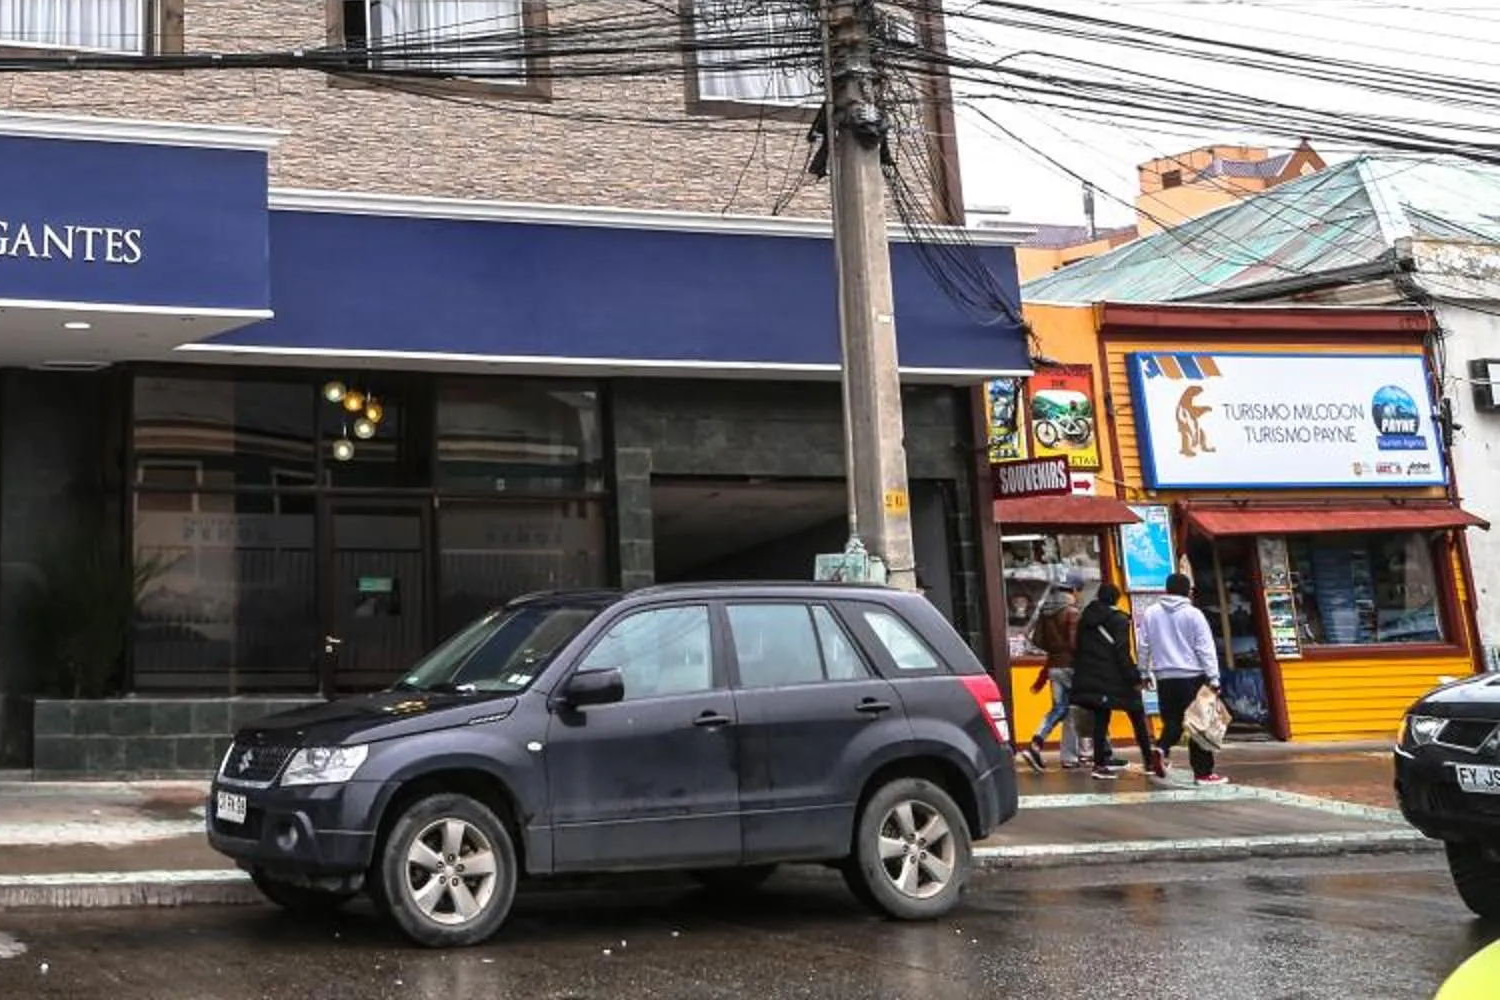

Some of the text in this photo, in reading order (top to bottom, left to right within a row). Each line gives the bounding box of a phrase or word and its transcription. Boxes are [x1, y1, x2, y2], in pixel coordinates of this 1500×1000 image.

[1222, 403, 1365, 421] TURISMO MILODON
[1244, 425, 1358, 444] TURISMO PAYNE
[1000, 459, 1067, 495] SOUVENIRS
